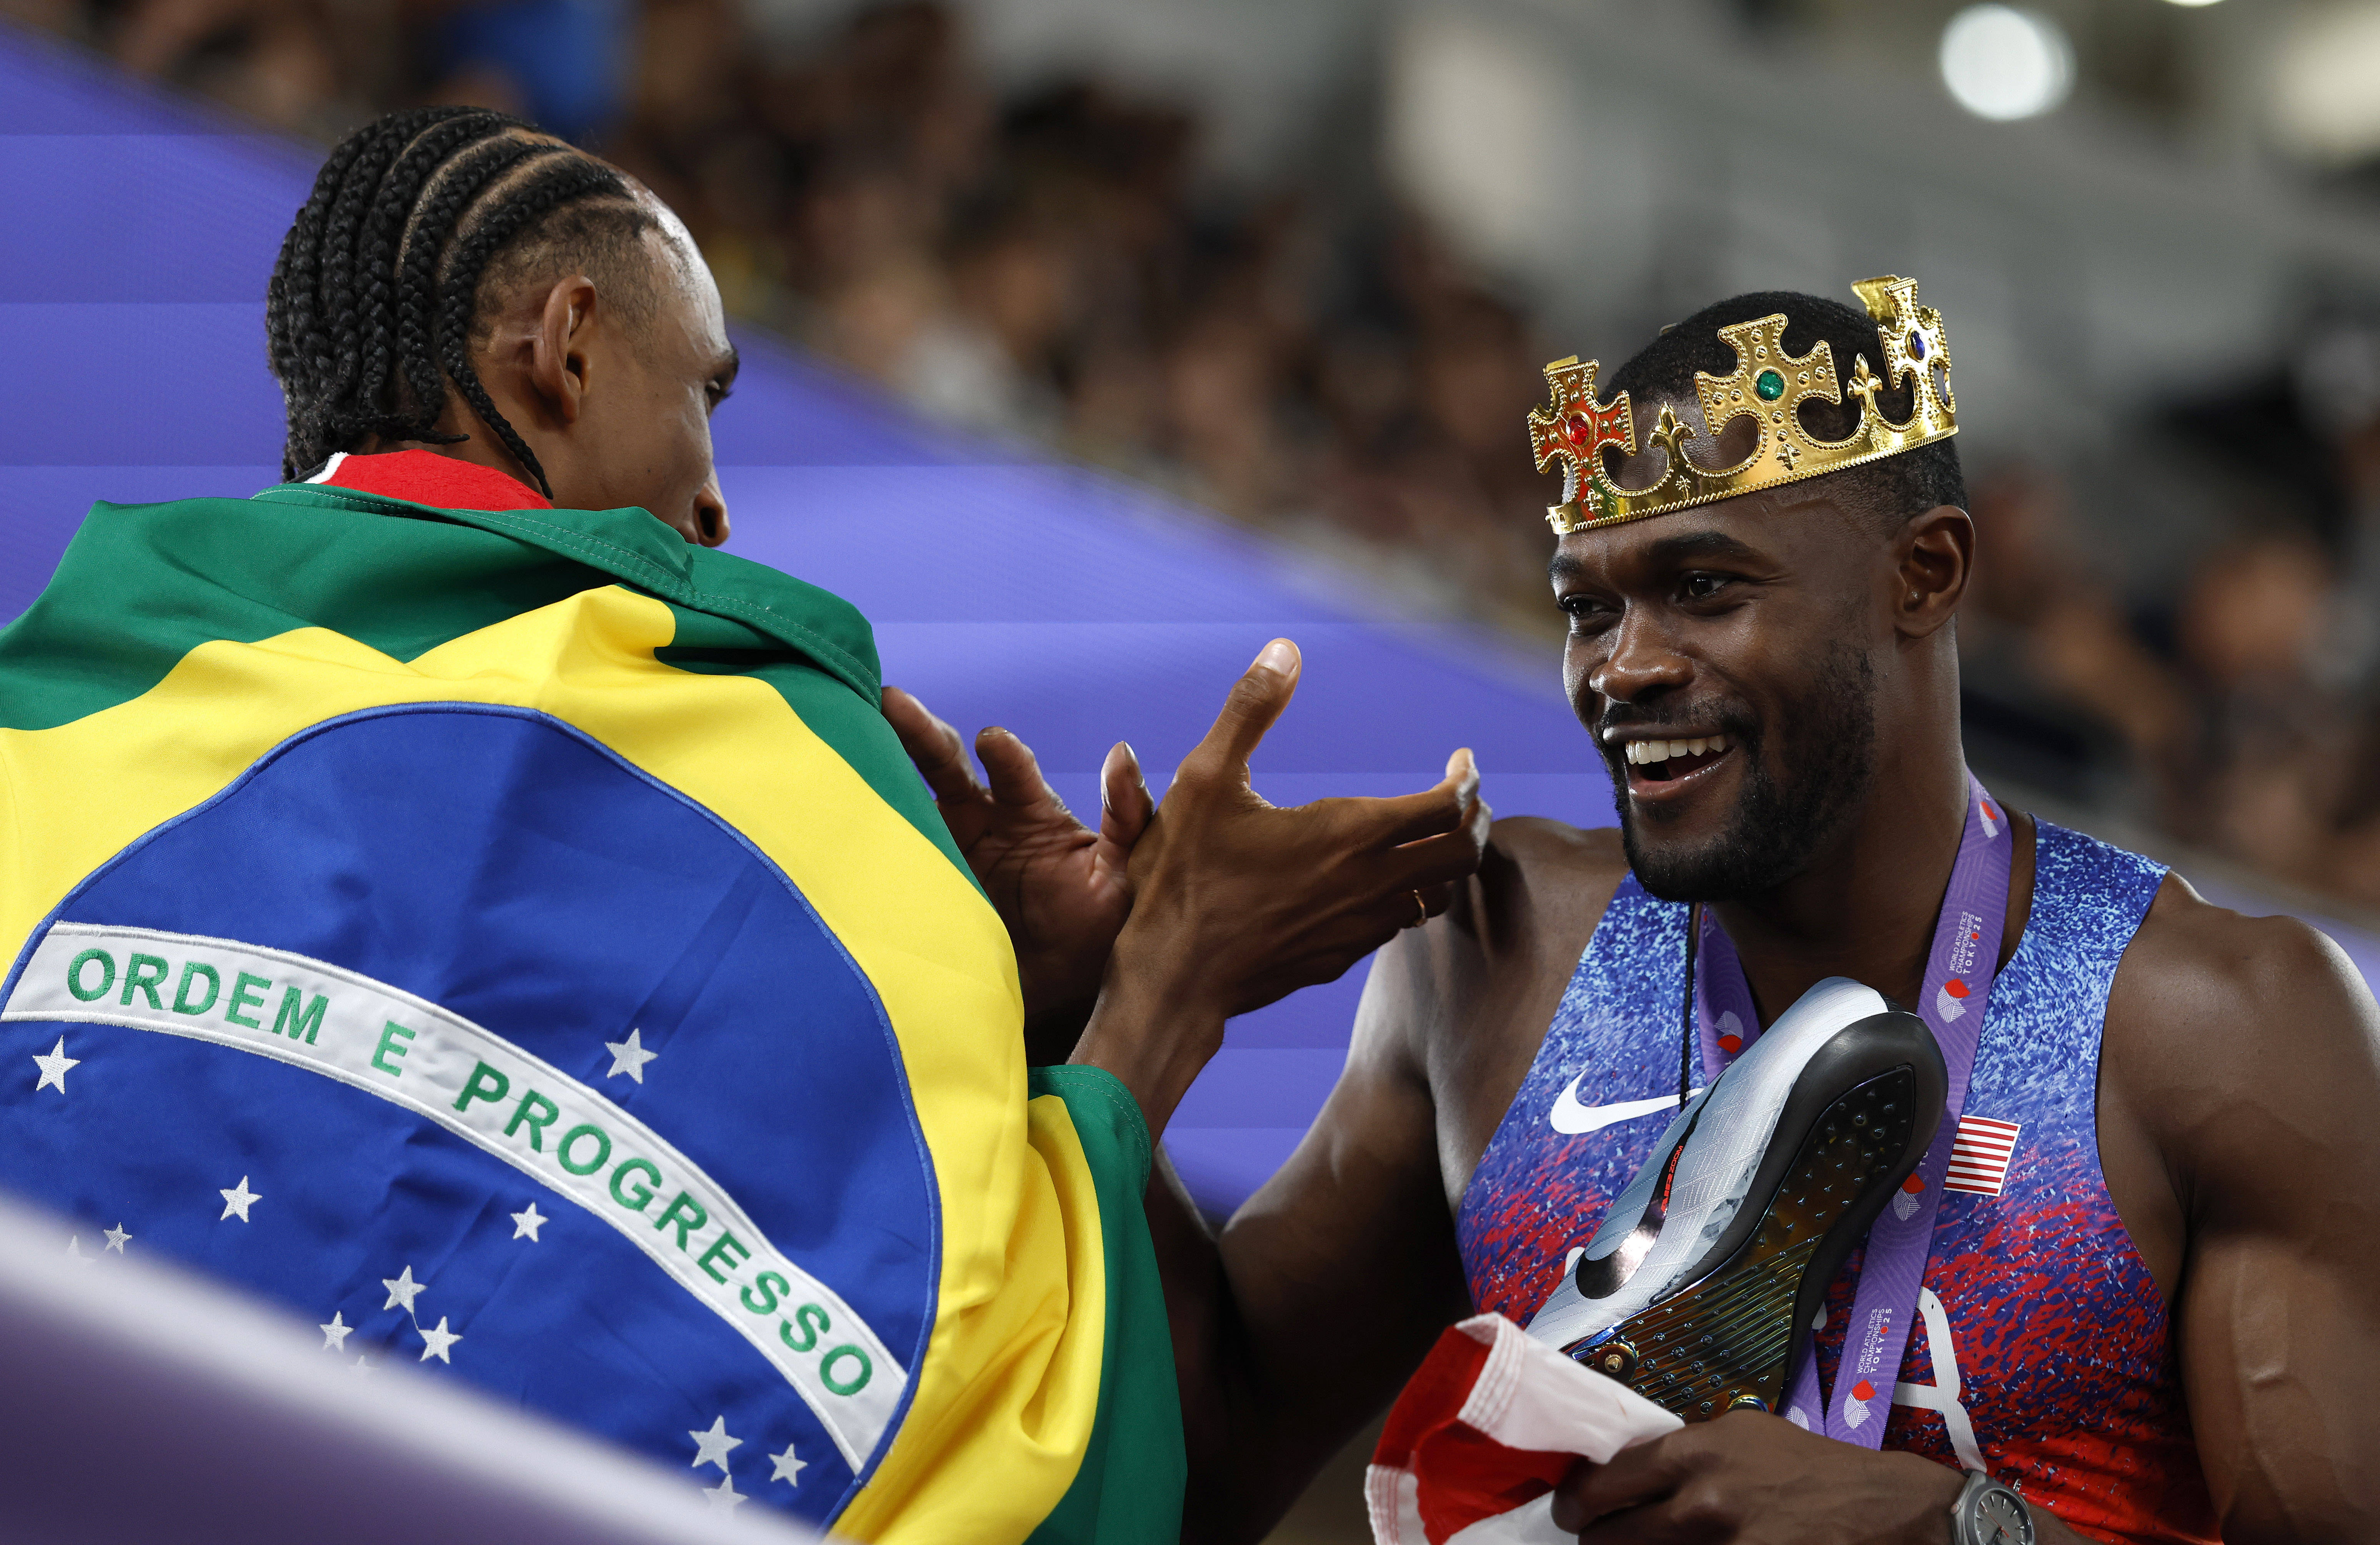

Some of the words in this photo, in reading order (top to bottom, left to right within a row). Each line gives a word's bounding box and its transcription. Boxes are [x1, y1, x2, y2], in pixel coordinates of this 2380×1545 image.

[1949, 947, 1960, 971] WORLD
[1955, 911, 1968, 947] ATHLETICS
[1956, 913, 1975, 974] CHAMPIONSHIPS
[67, 948, 330, 1045] ORDEM
[371, 1020, 416, 1076] E
[453, 1060, 873, 1397] PROGRESSO
[1669, 1145, 1684, 1174] ZOOM
[1857, 1348, 1868, 1374] WORLD
[1864, 1308, 1878, 1347] ATHLETICS
[1863, 1308, 1884, 1374] CHAMPIONSHIPS
